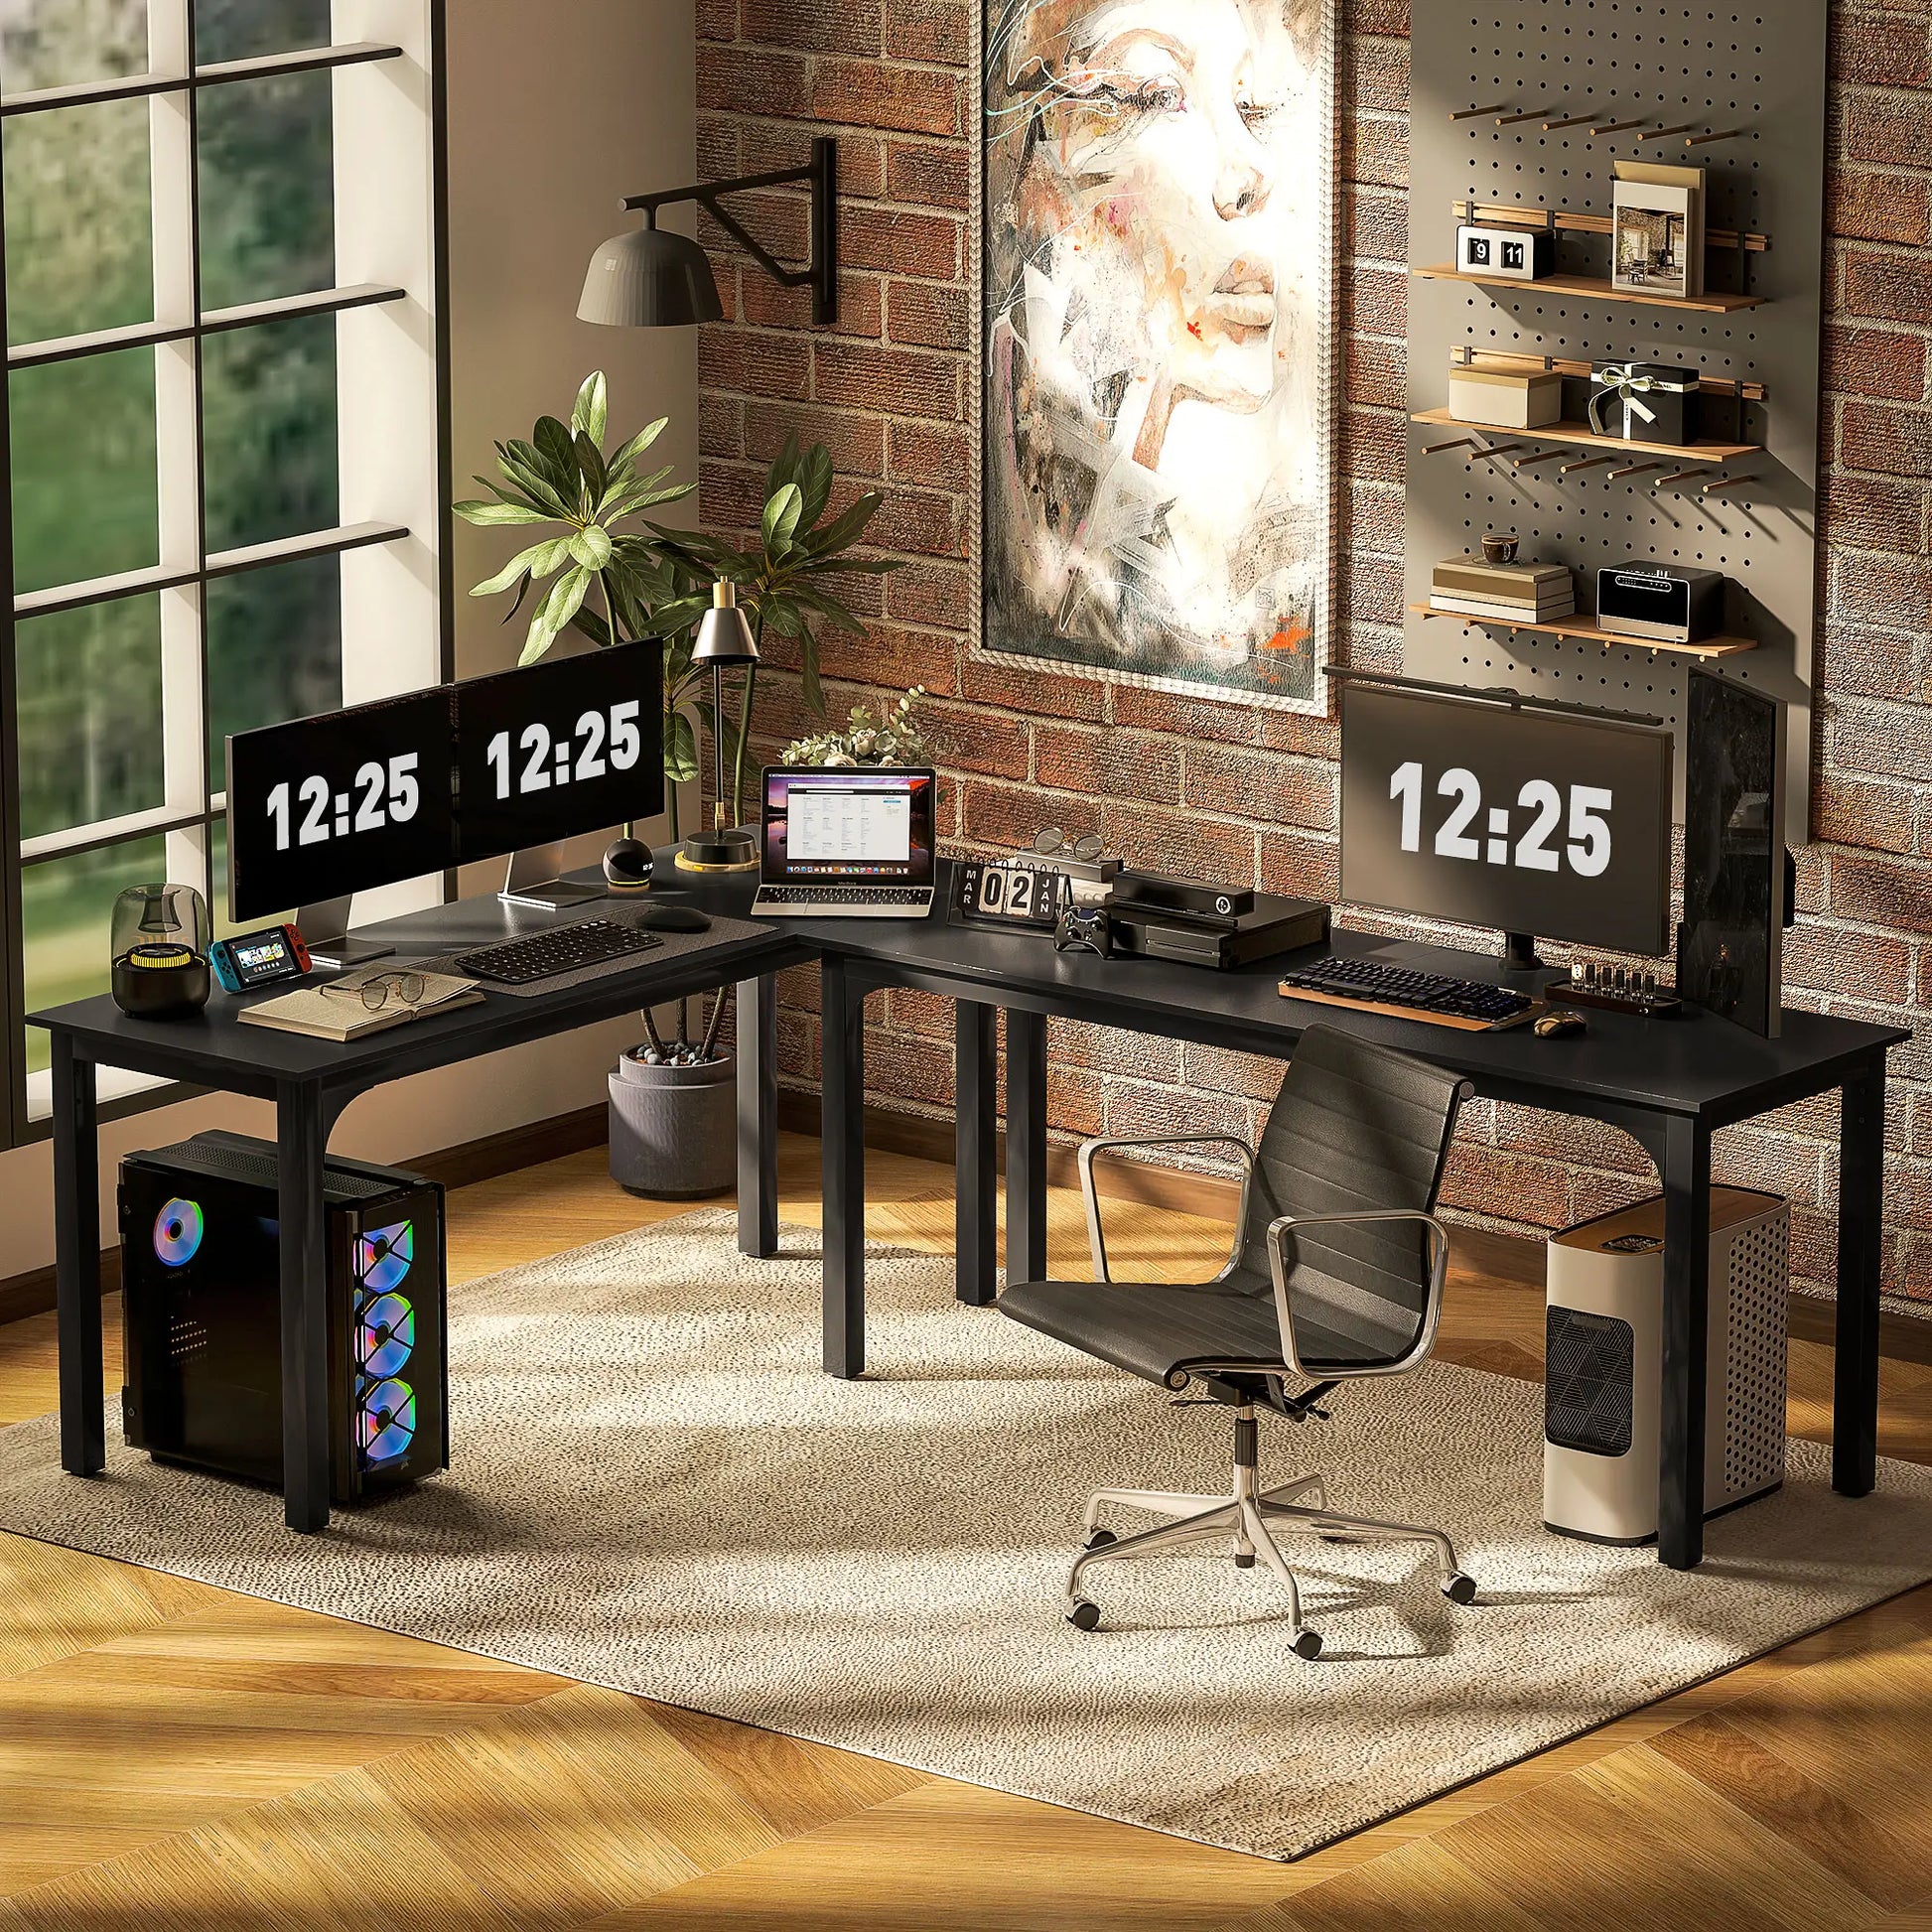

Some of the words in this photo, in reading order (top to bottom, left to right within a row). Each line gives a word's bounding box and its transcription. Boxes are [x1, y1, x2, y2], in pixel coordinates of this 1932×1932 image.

[1476, 243, 1487, 259] 9
[1506, 247, 1523, 263] 11
[487, 700, 640, 800] 12:25
[267, 753, 419, 851] 12:25
[1390, 762, 1612, 877] 12:25
[963, 870, 976, 903] MAR
[1040, 879, 1050, 912] JAN
